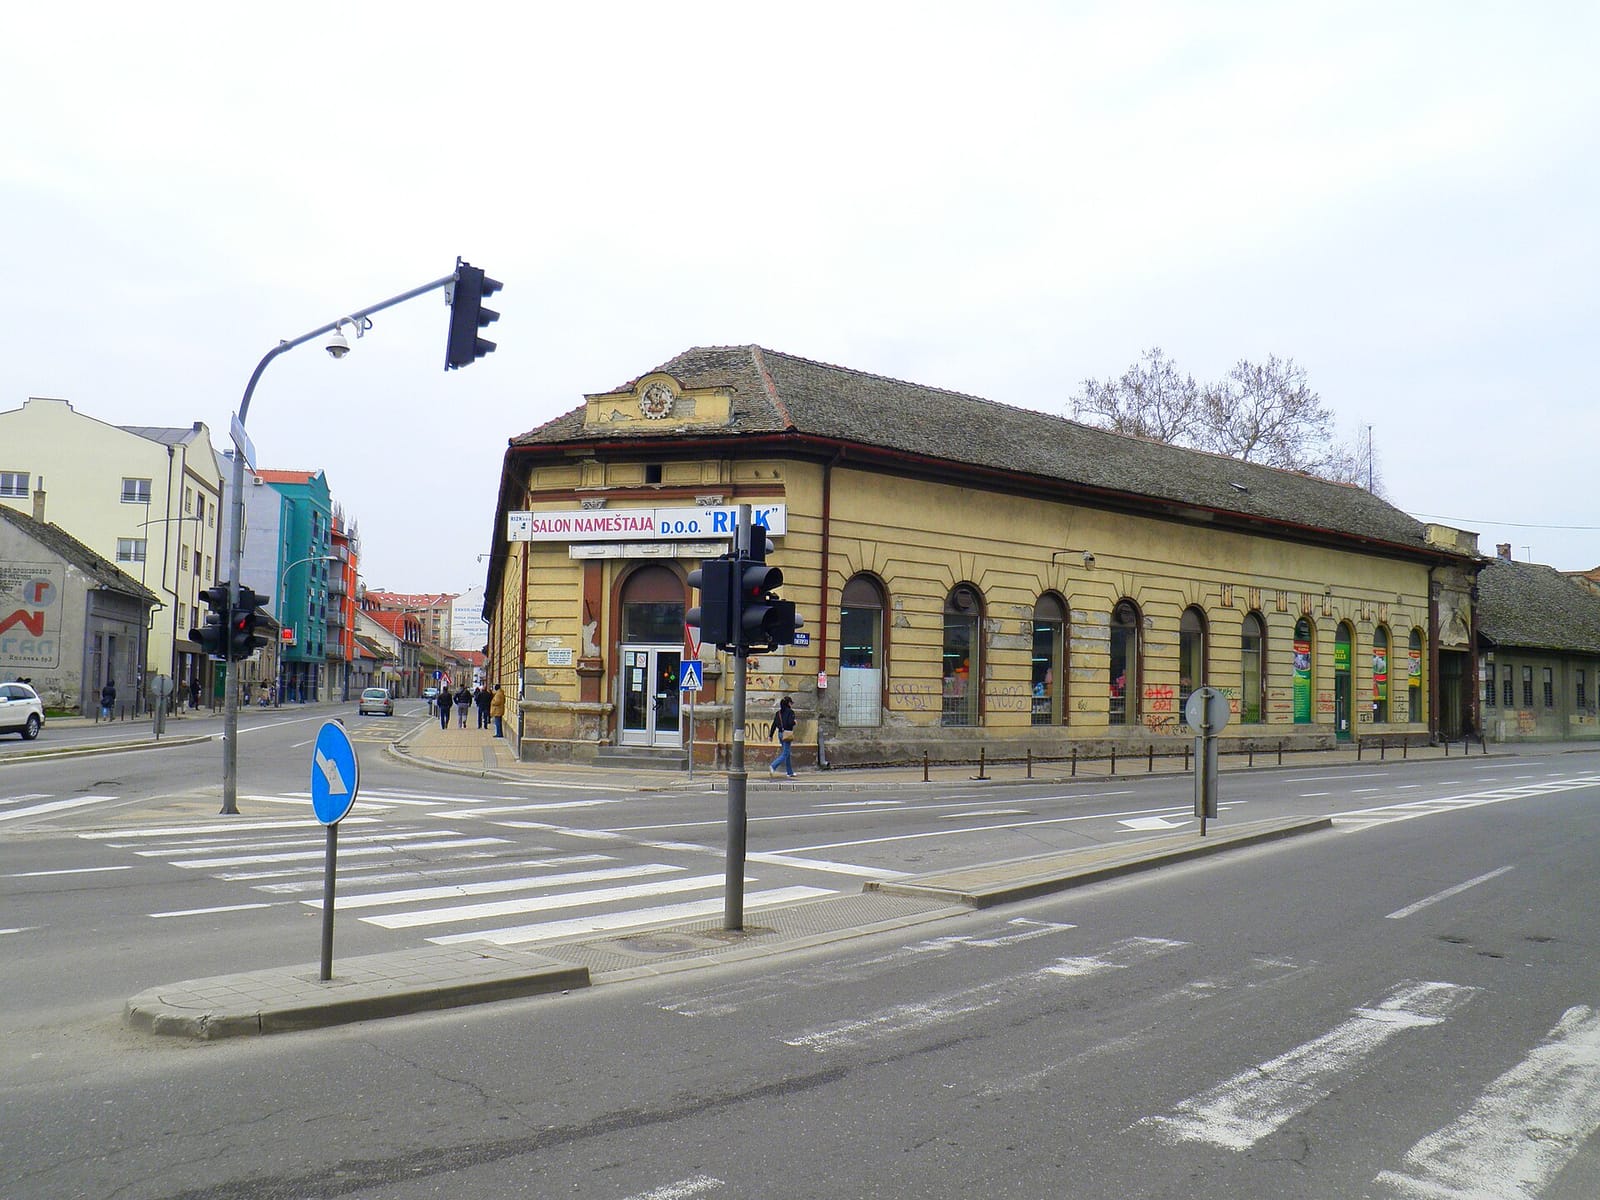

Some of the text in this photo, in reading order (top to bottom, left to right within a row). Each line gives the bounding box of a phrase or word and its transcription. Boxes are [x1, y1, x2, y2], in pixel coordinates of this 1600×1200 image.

[533, 508, 778, 534] SALON NAMEŠTAJA D.O.O. “RIK”
